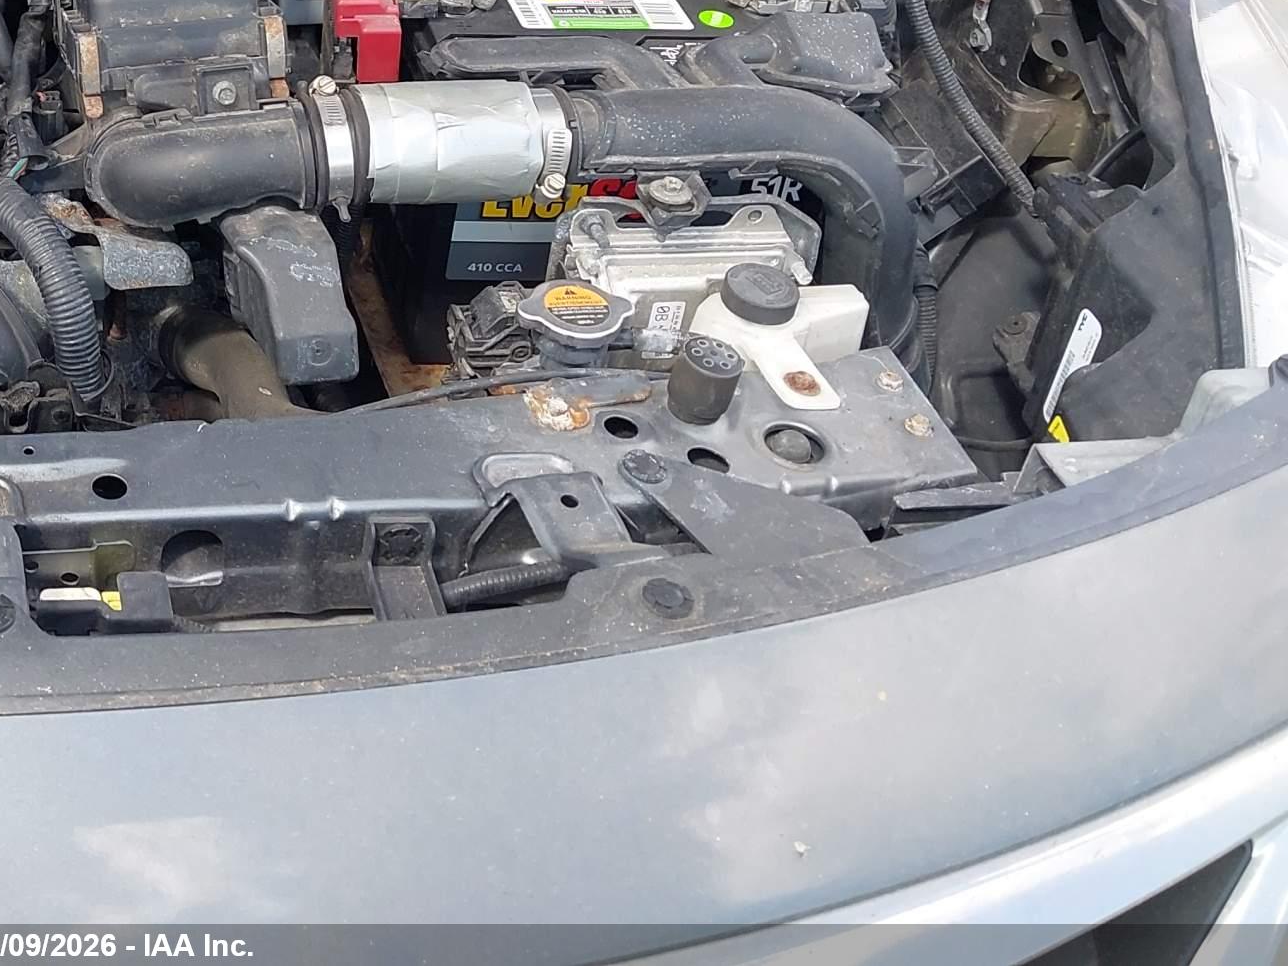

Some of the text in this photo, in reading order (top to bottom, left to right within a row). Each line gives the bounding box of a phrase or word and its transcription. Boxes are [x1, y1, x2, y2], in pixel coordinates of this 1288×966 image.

[751, 176, 803, 202] 51R
[467, 263, 522, 273] 410 CCA
